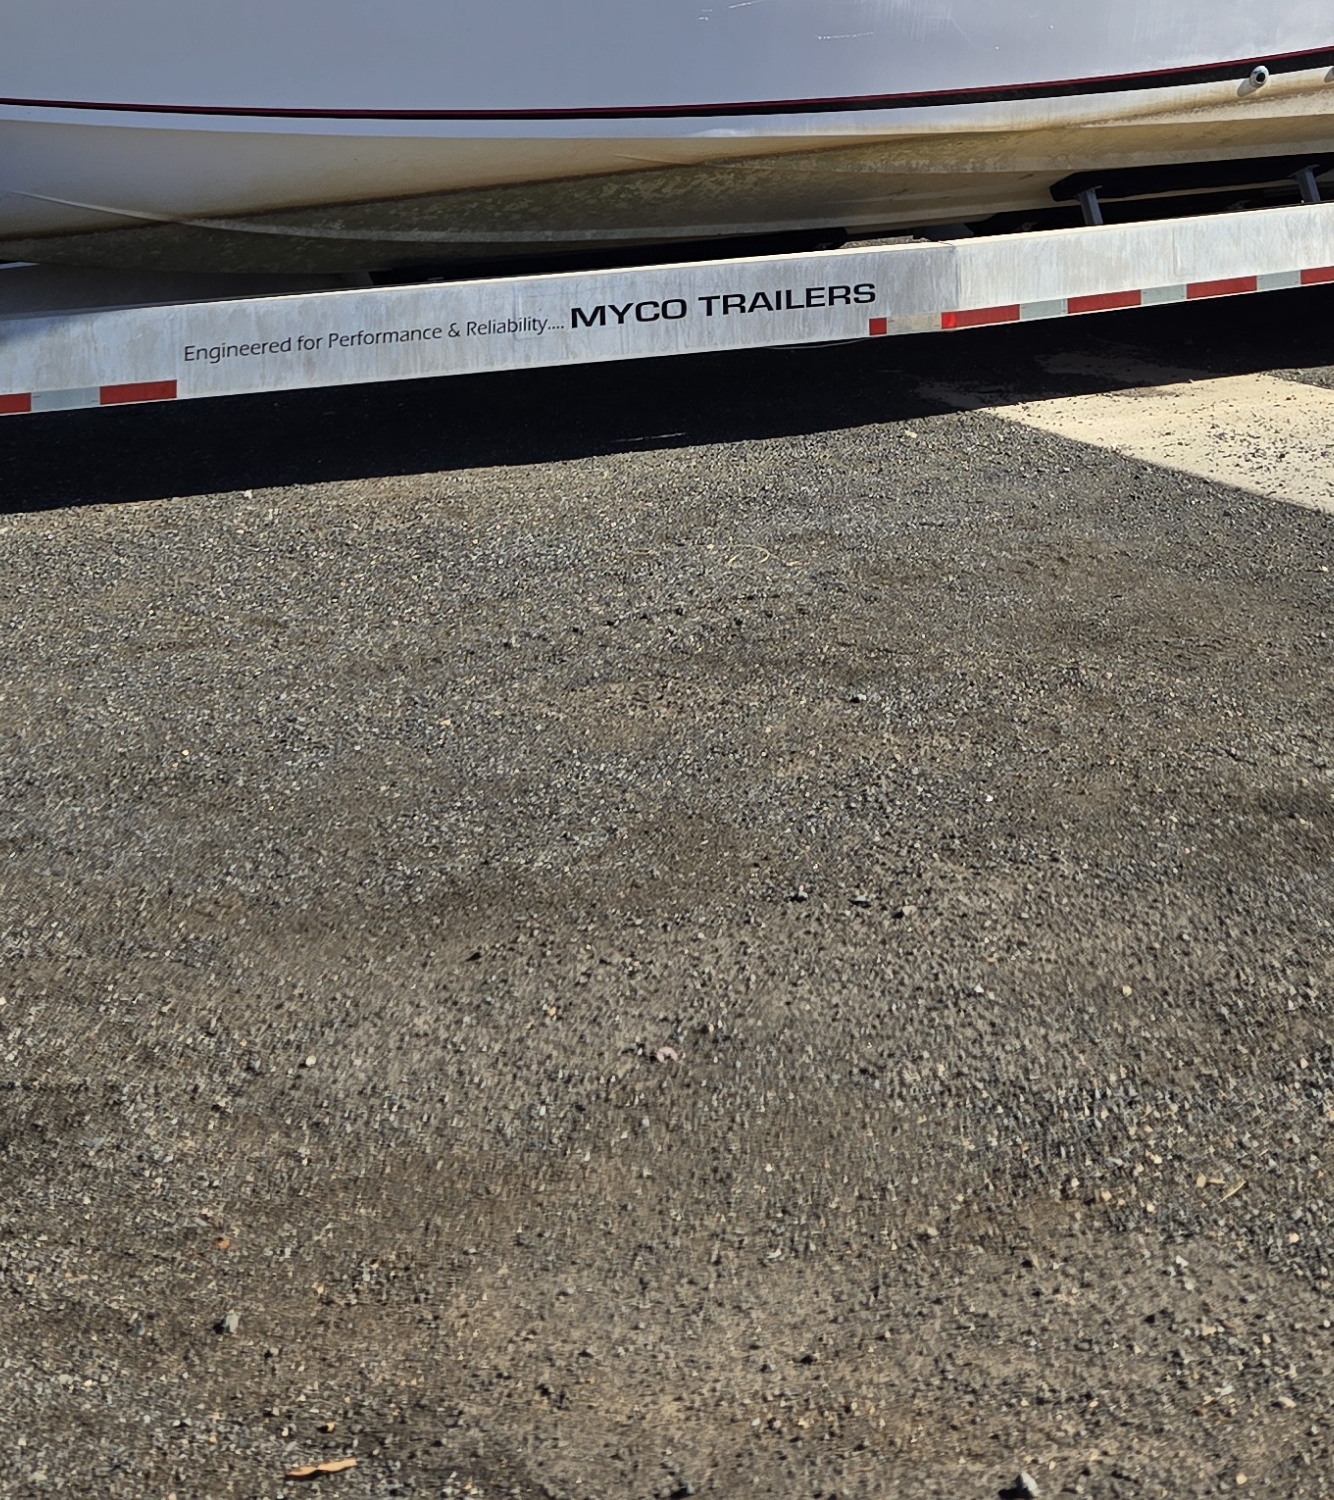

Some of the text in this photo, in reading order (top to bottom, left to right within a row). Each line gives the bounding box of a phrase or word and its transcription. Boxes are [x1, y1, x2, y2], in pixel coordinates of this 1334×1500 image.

[570, 283, 876, 330] MYCO TRAILERS
[183, 337, 292, 364] Engineered
[296, 334, 323, 350] for
[328, 324, 443, 349] Performance
[447, 322, 461, 338] &
